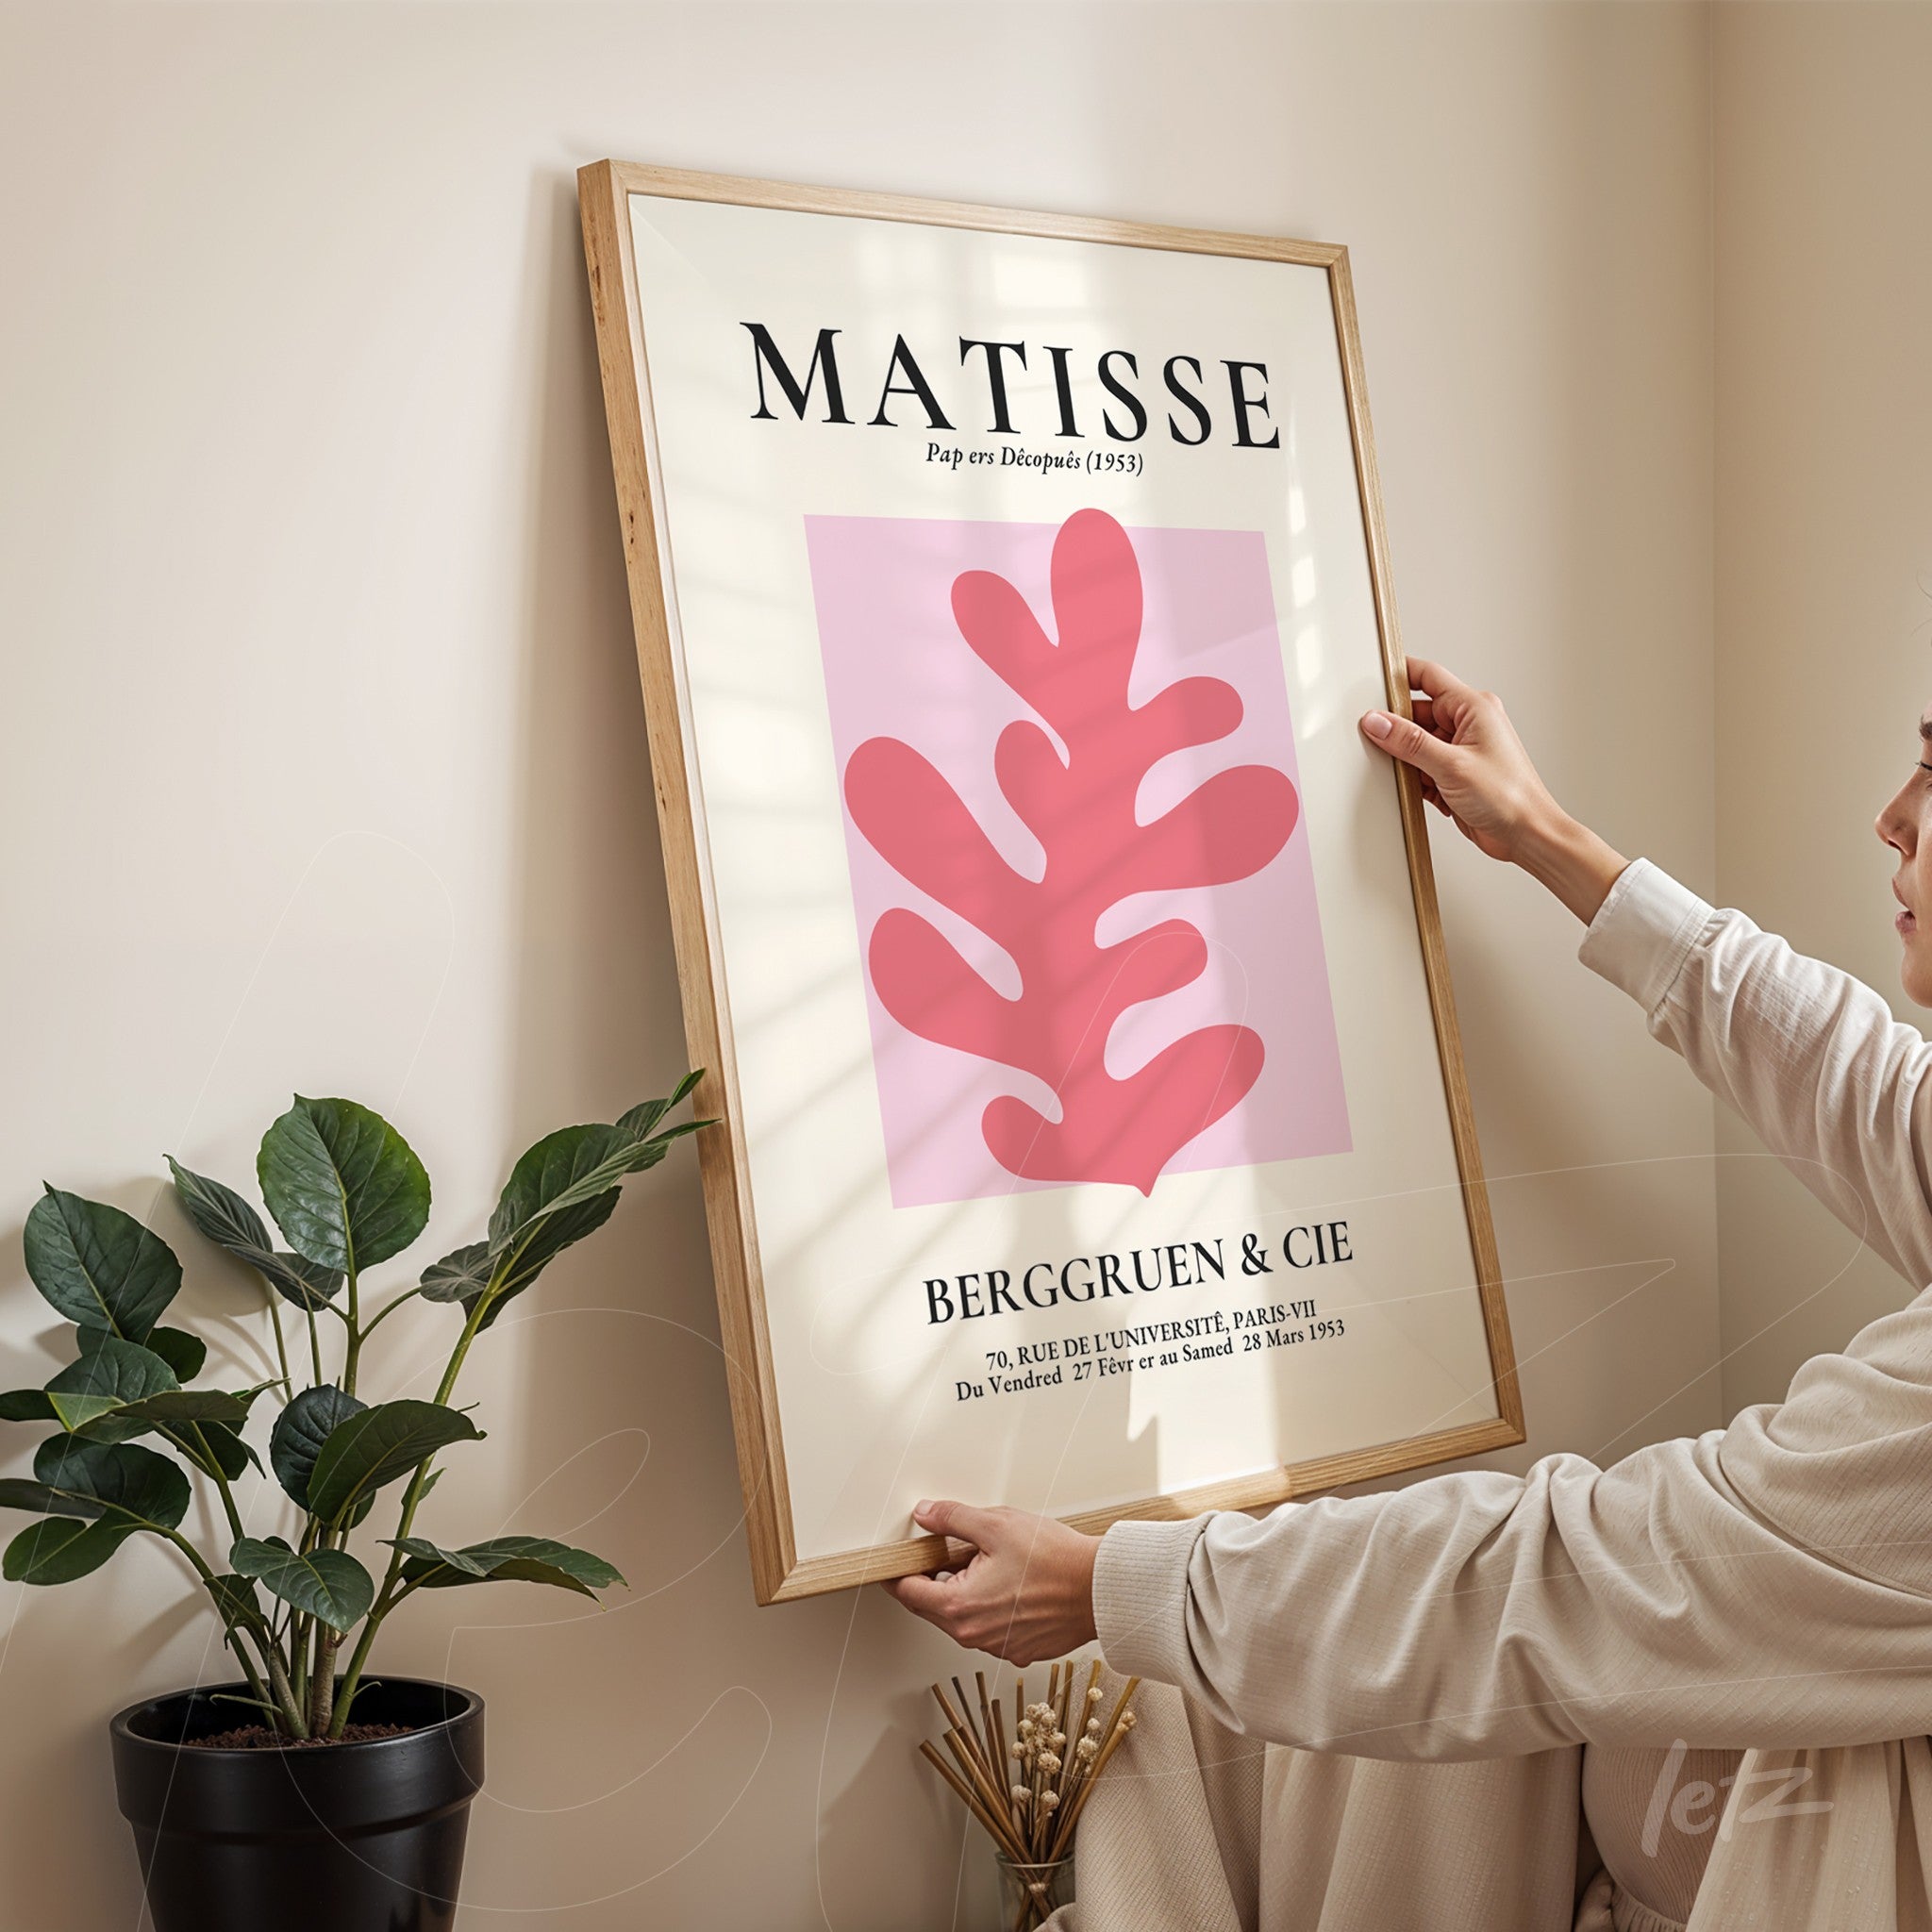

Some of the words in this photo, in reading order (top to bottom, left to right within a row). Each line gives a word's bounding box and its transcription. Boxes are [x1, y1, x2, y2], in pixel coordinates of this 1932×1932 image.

[739, 322, 1281, 450] MATISSE
[1086, 450, 1143, 477] (1953)
[922, 1238, 1225, 1325] BERGGRUEN
[1241, 1232, 1274, 1276] &
[1282, 1221, 1354, 1269] CIE
[955, 1381, 985, 1402] Du
[987, 1364, 1063, 1394] Vendred
[1072, 1360, 1092, 1381] 27
[1158, 1351, 1179, 1367] au
[1182, 1336, 1234, 1362] Samed
[1241, 1332, 1262, 1353] 28
[1265, 1328, 1305, 1348] Mars
[1308, 1319, 1345, 1341] 1953
[985, 1350, 1014, 1372] 70,
[1016, 1341, 1060, 1366] RUE
[1062, 1336, 1091, 1358] DE
[1232, 1299, 1317, 1330] PARIS-VII
